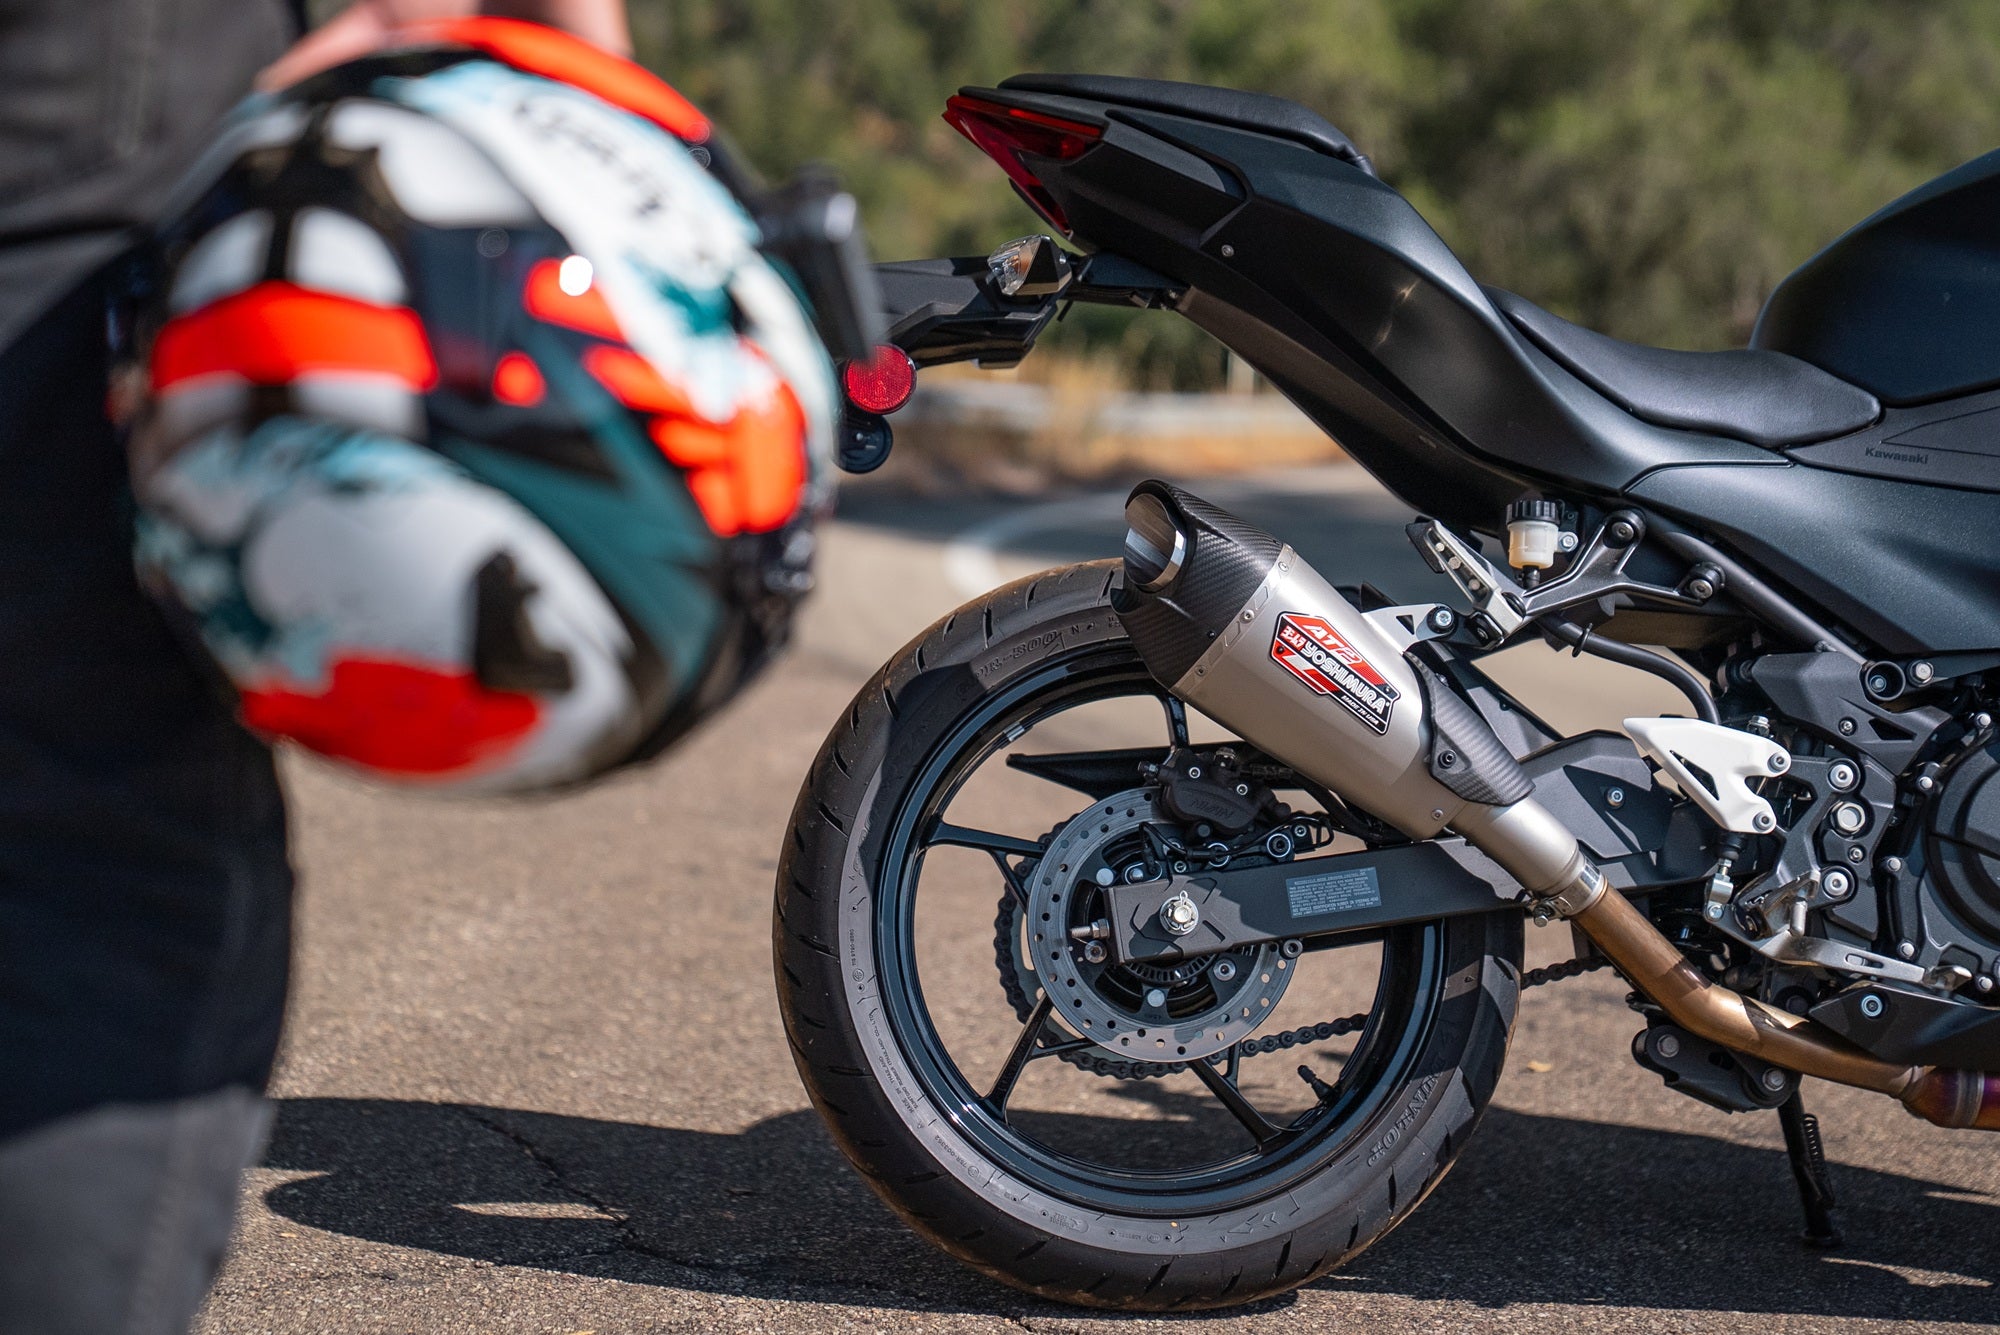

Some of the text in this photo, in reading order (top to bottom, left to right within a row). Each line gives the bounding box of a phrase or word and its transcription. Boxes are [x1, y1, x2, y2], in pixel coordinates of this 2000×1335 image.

[1865, 447, 1929, 464] Kawasaki
[1302, 623, 1363, 665] AT2
[1300, 641, 1385, 715] YOSHIMURA
[1341, 694, 1359, 710] MADE
[1366, 713, 1380, 726] USA
[878, 1055, 896, 1084] THAILAND
[902, 1097, 914, 1114] MADE
